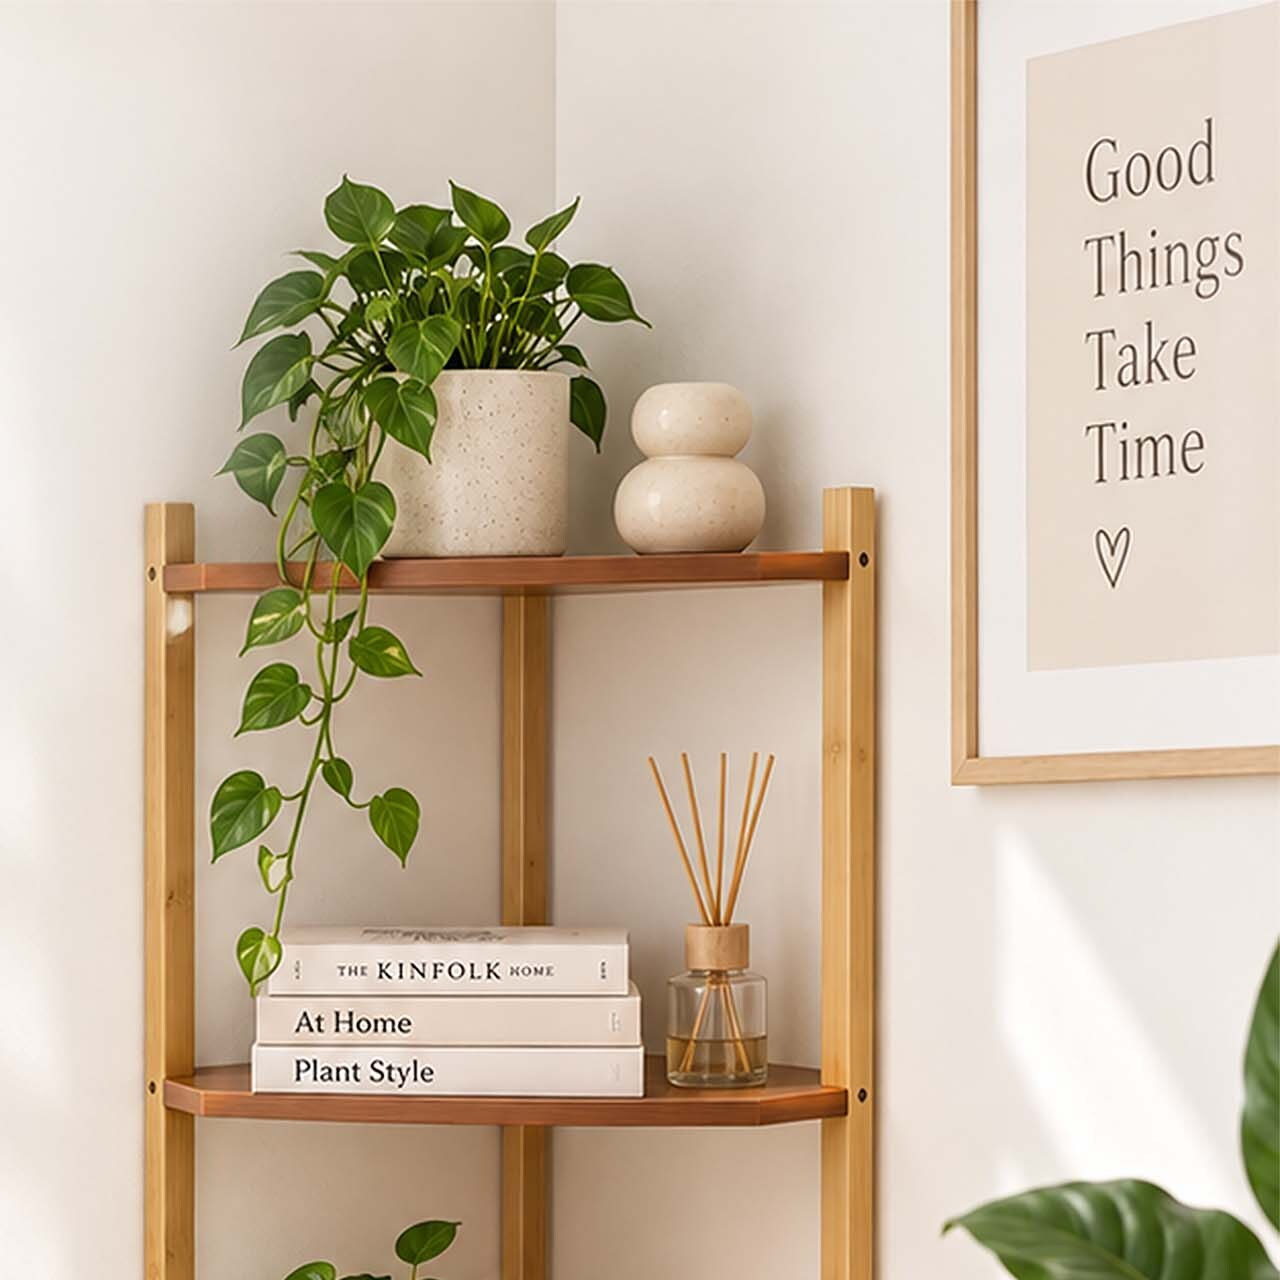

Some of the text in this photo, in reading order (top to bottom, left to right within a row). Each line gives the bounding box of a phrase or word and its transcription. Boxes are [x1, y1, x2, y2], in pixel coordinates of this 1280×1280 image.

[1085, 117, 1215, 203] Good
[1084, 229, 1245, 300] Things
[1085, 320, 1197, 392] Take
[1085, 421, 1205, 484] Time
[337, 965, 368, 977] THE
[377, 962, 502, 980] KINFOLK
[294, 1010, 412, 1034] At Home
[294, 1058, 435, 1089] Plant Style
